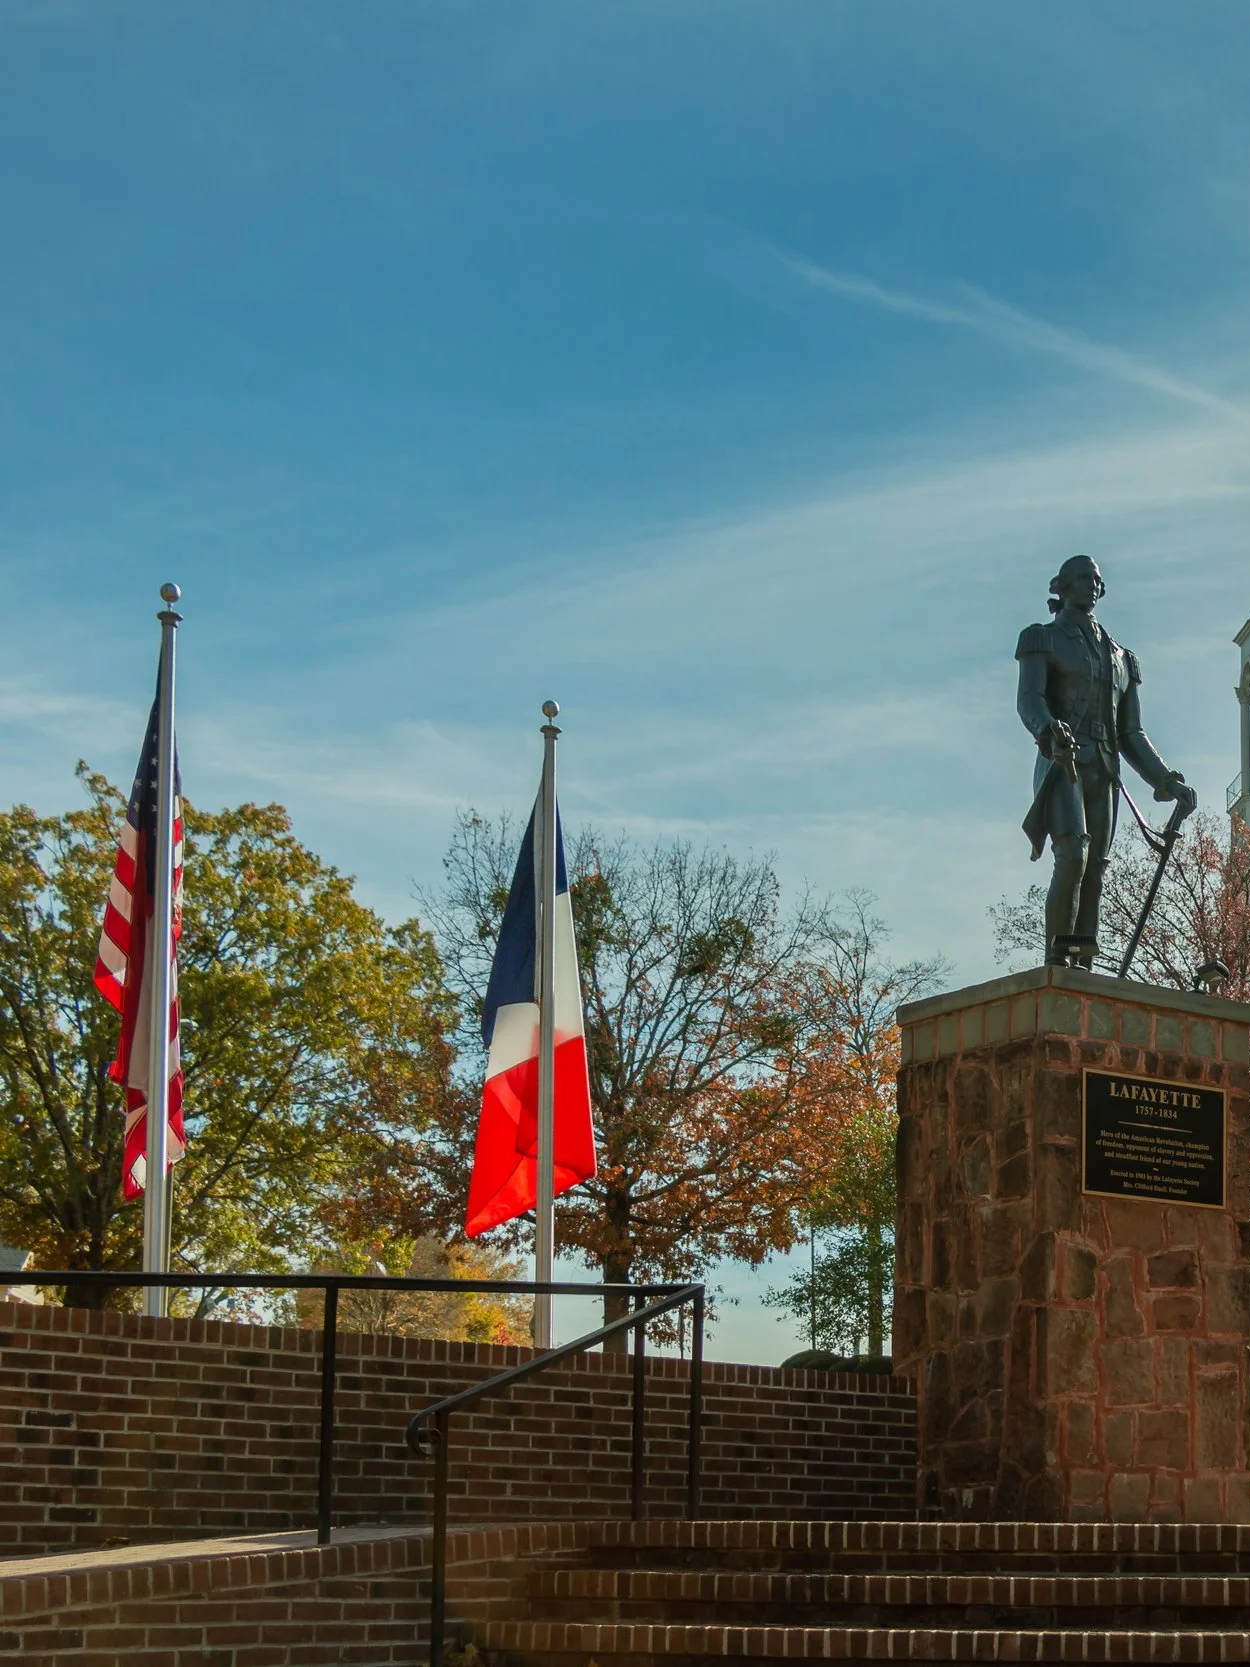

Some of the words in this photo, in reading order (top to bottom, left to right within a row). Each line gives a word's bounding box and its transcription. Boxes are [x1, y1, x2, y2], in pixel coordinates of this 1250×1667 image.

[1110, 1082, 1201, 1109] LAFAYETTE
[1135, 1105, 1177, 1119] 1757-1834
[1101, 1130, 1113, 1138] Hero
[1131, 1134, 1155, 1143] American
[1156, 1137, 1184, 1148] Revolution,
[1186, 1142, 1209, 1151] champion
[1126, 1144, 1149, 1152] opponent
[1157, 1148, 1174, 1157] slavery
[1116, 1152, 1138, 1161] steadfast
[1140, 1154, 1155, 1163] friend
[1172, 1160, 1187, 1168] young
[1110, 1169, 1128, 1177] Erected
[1147, 1173, 1152, 1181] by
[1162, 1175, 1182, 1184] Lafayette
[1184, 1178, 1199, 1187] Society
